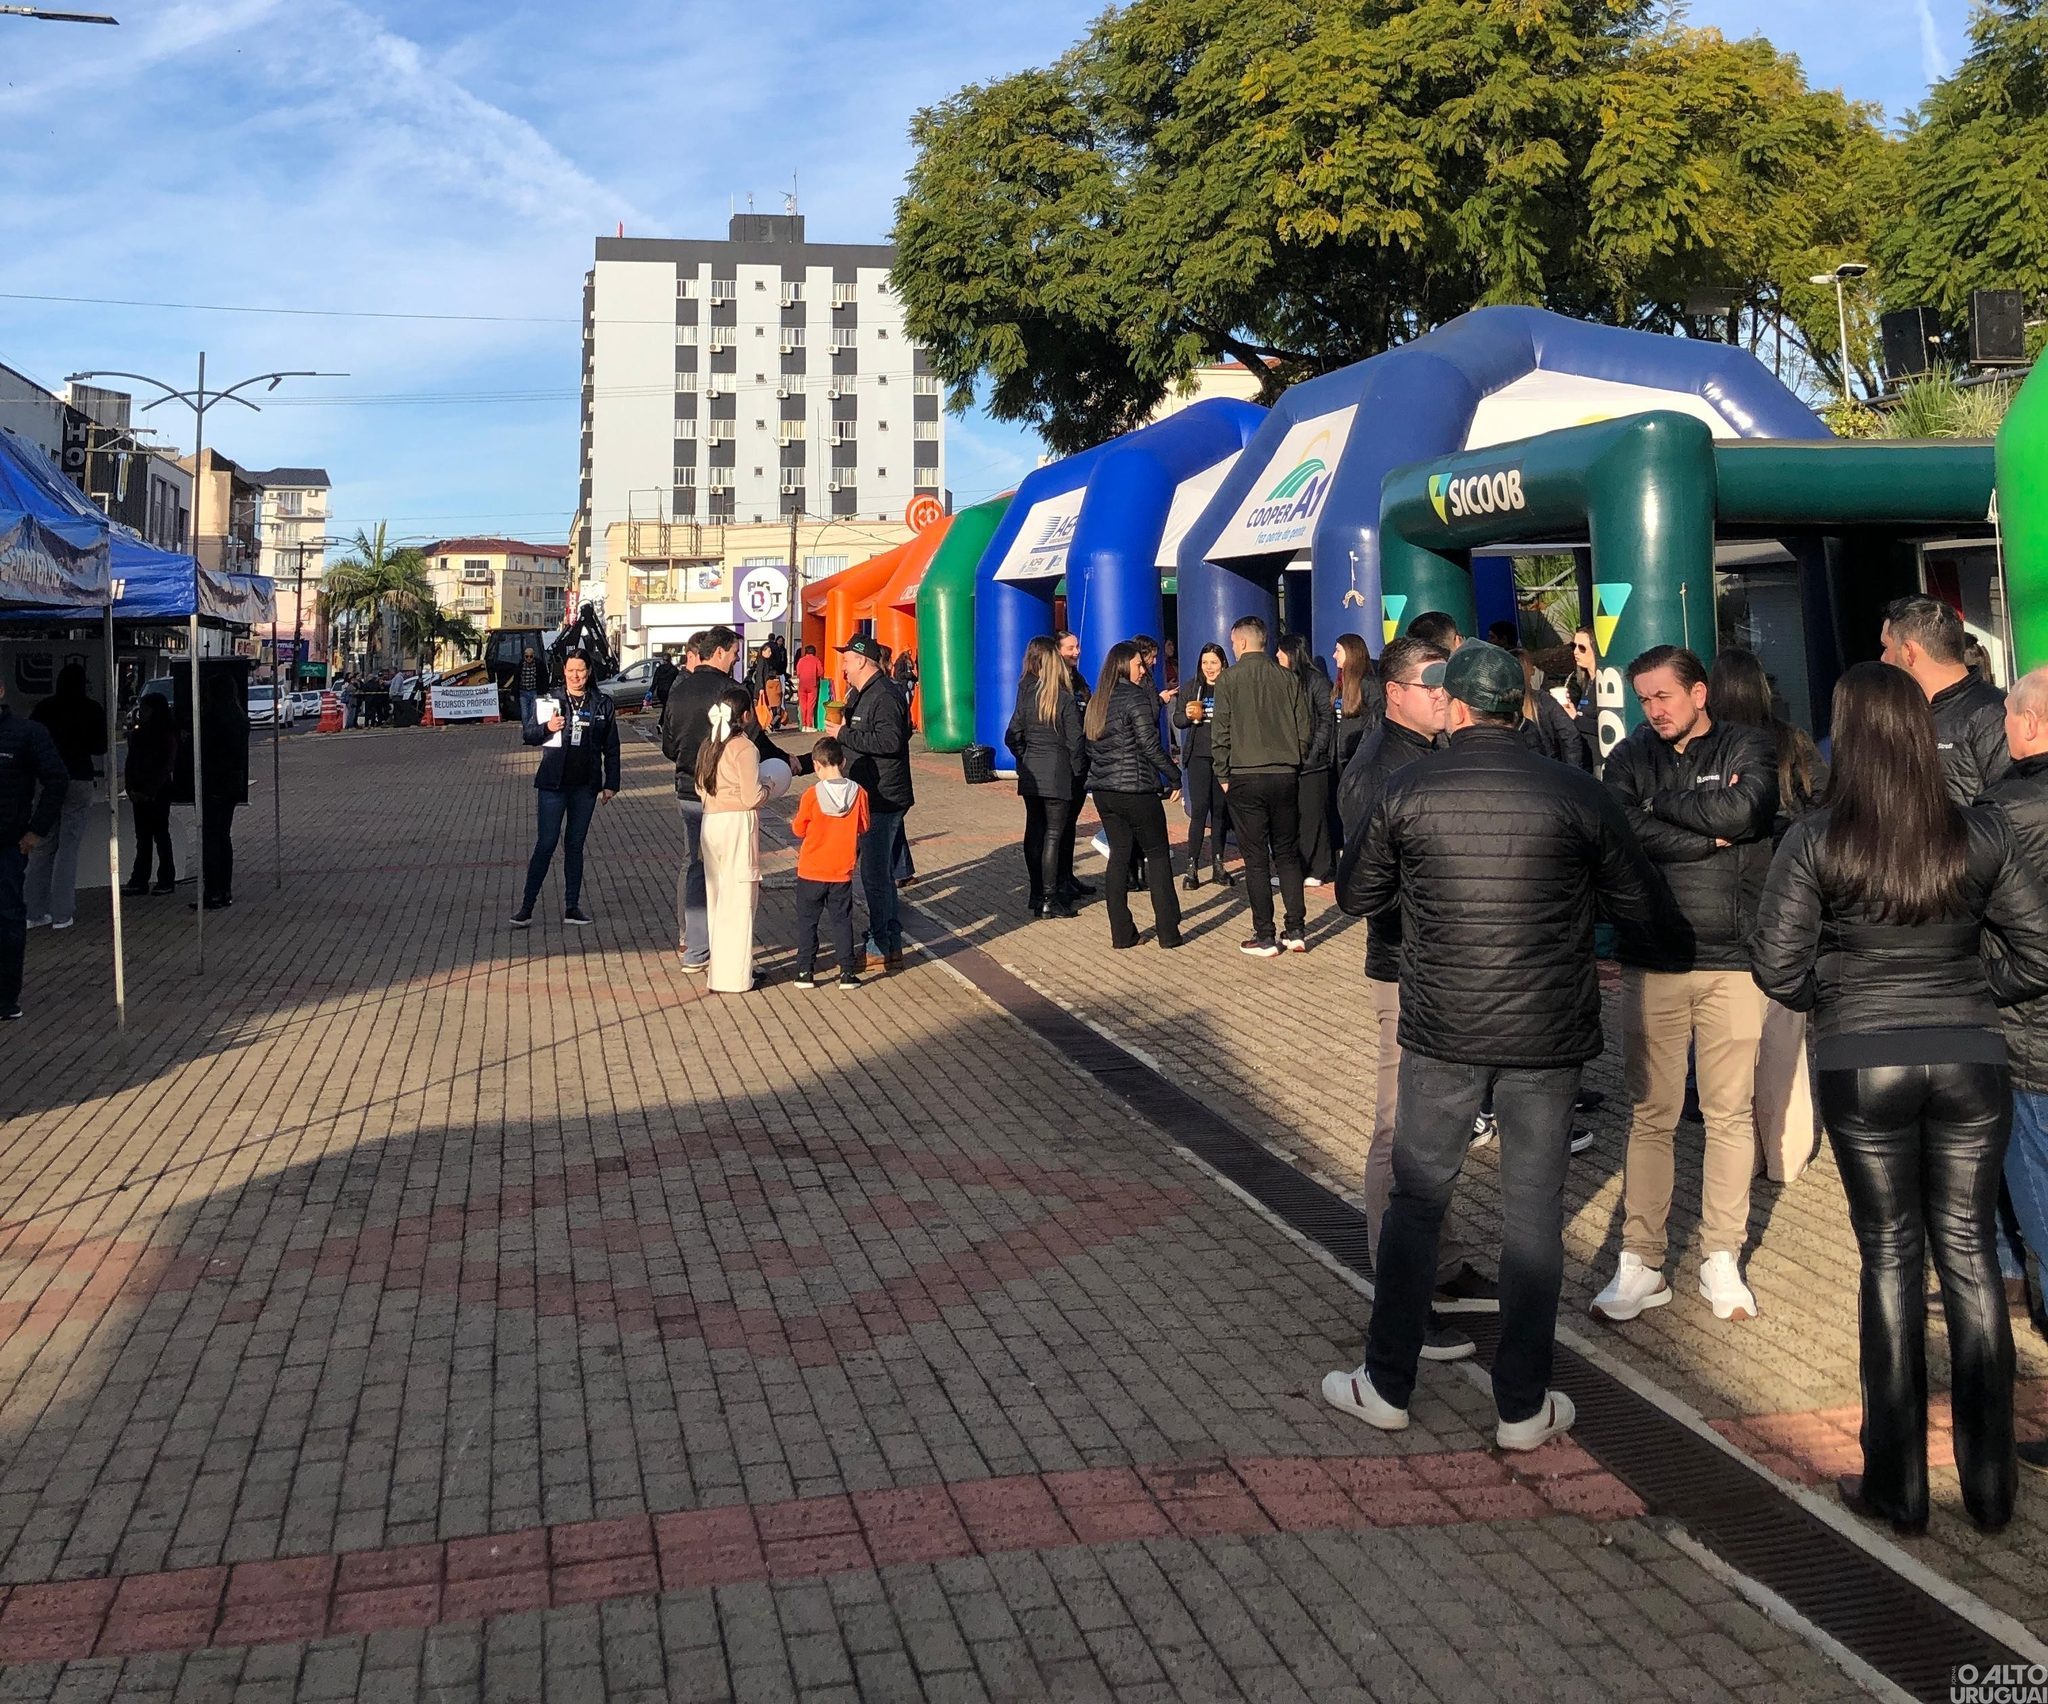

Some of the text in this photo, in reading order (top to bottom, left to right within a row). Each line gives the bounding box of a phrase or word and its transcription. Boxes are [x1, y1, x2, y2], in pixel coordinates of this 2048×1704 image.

[1449, 469, 1525, 517] SICOOB
[434, 697, 498, 709] RECURSOS PRÓPRIOS
